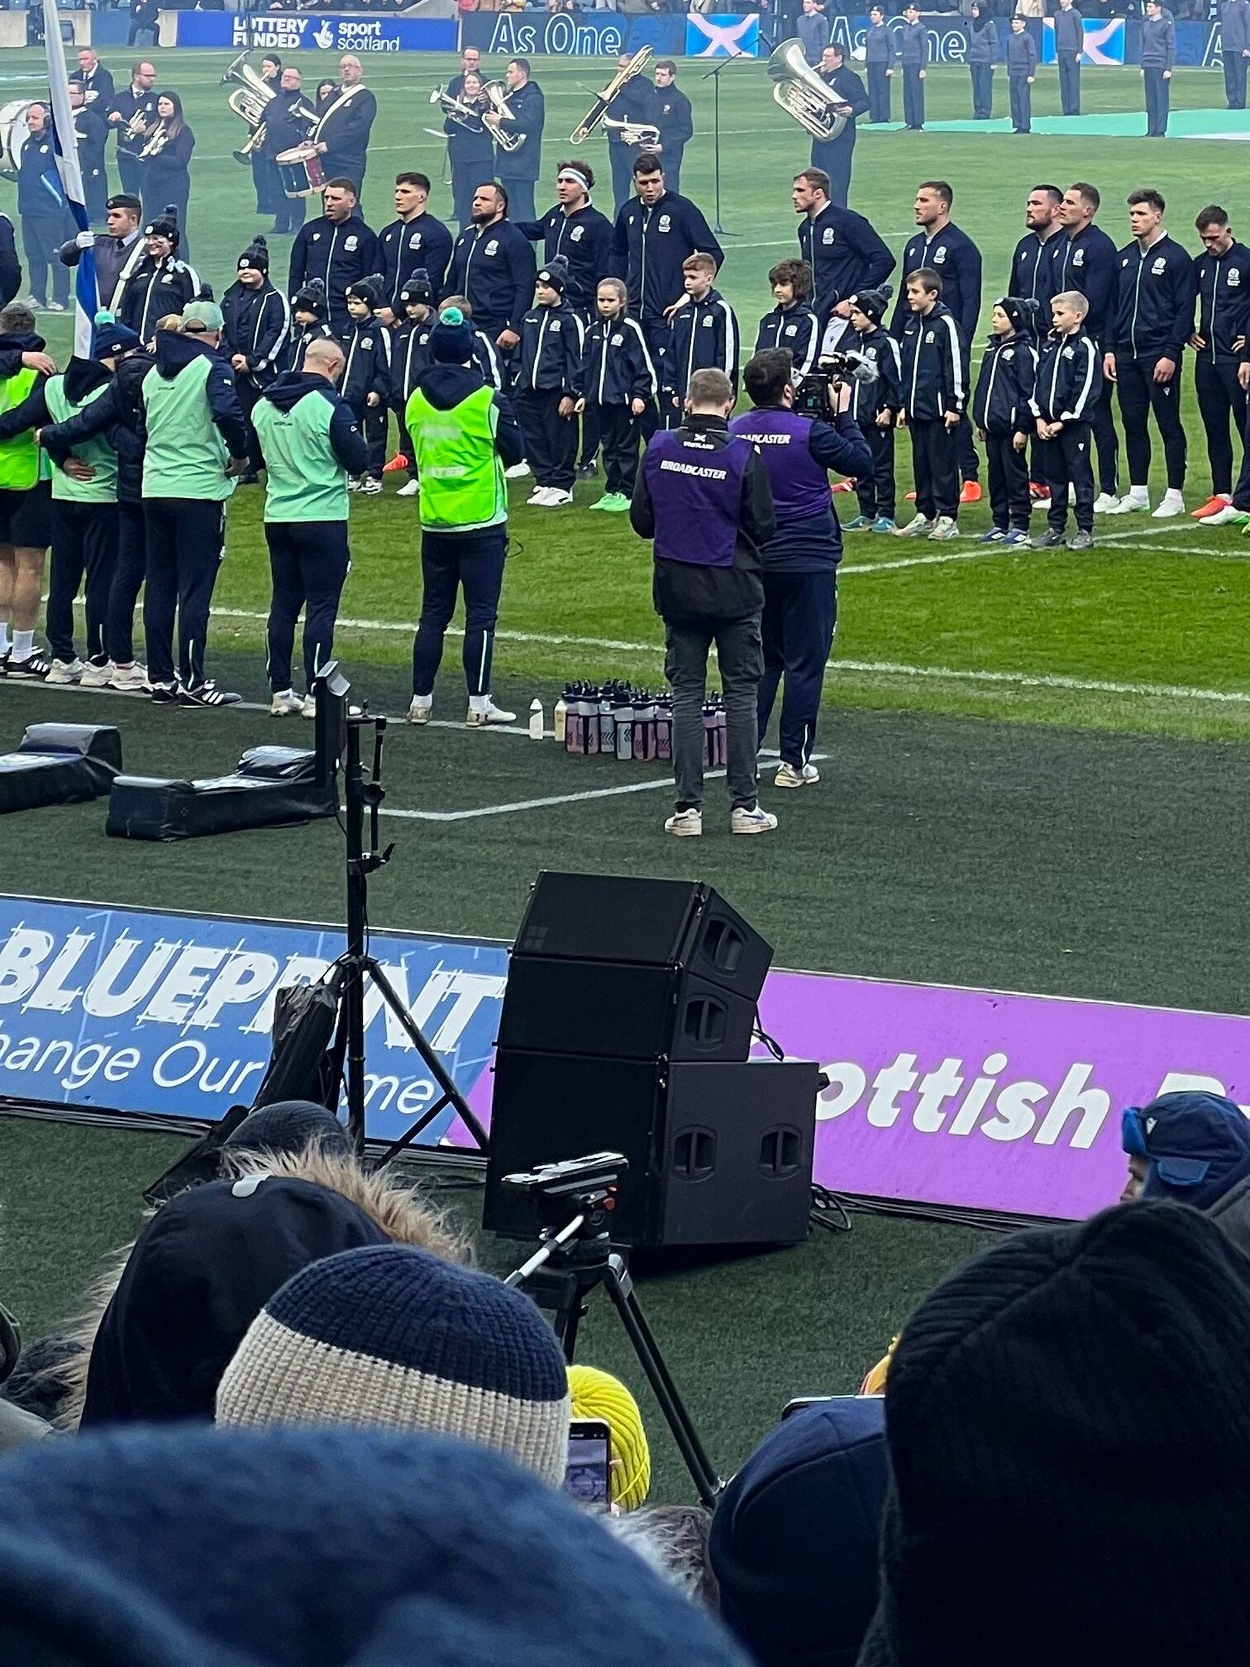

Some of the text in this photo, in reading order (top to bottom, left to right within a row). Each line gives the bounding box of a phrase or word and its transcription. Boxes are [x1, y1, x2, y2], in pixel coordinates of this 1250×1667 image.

[337, 36, 399, 51] scotland
[338, 21, 381, 37] sport
[488, 12, 622, 55] As One
[660, 460, 727, 480] BROADCASTER
[0, 920, 508, 1056] BLUEPRNT
[152, 1039, 266, 1095] Our
[814, 1052, 1112, 1150] ottish
